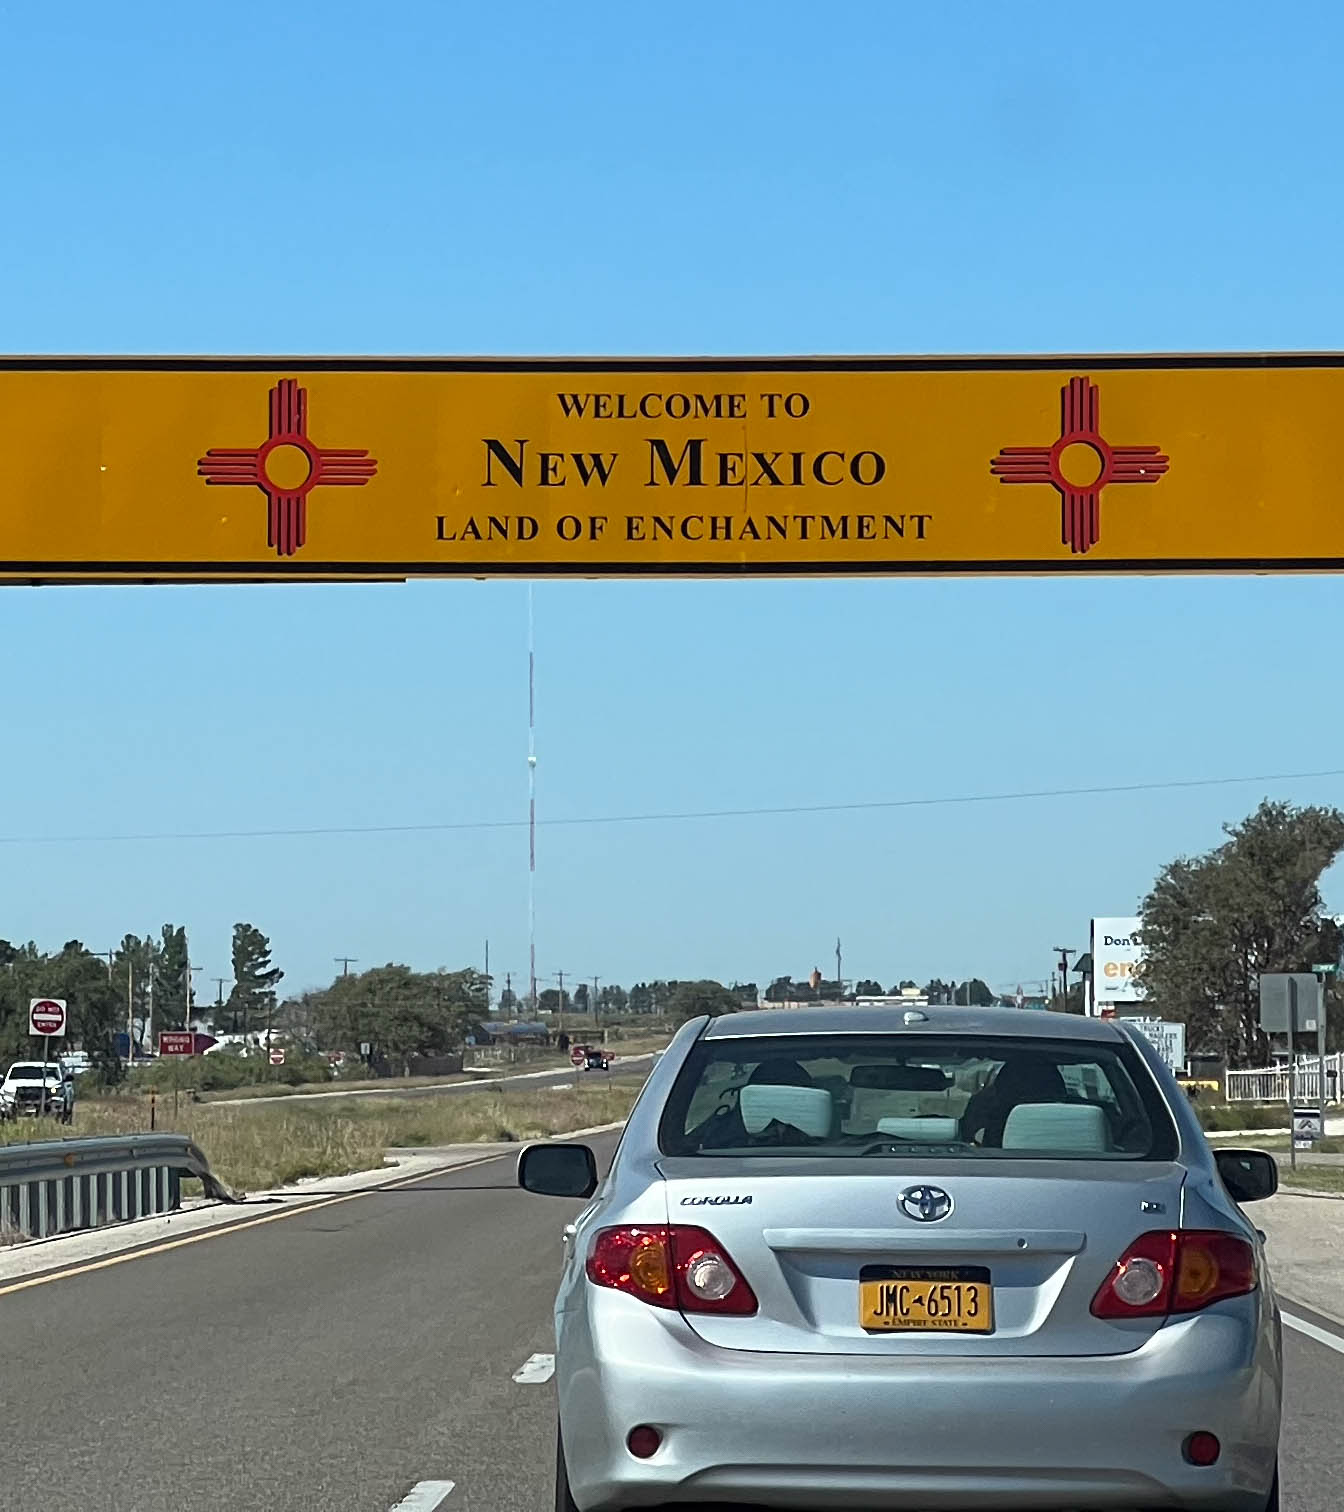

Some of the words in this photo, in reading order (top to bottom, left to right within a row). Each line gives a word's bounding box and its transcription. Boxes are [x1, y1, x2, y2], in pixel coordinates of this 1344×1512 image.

[557, 393, 747, 419] WELCOME
[760, 392, 811, 419] TO
[481, 438, 619, 488] NEW
[644, 437, 887, 488] MEXICO
[436, 516, 539, 541] LAND
[556, 516, 608, 541] OF
[626, 514, 933, 541] ENCHANTMENT
[167, 1044, 184, 1052] WAY
[679, 1195, 753, 1206] COROLLA
[931, 1319, 958, 1327] STATE
